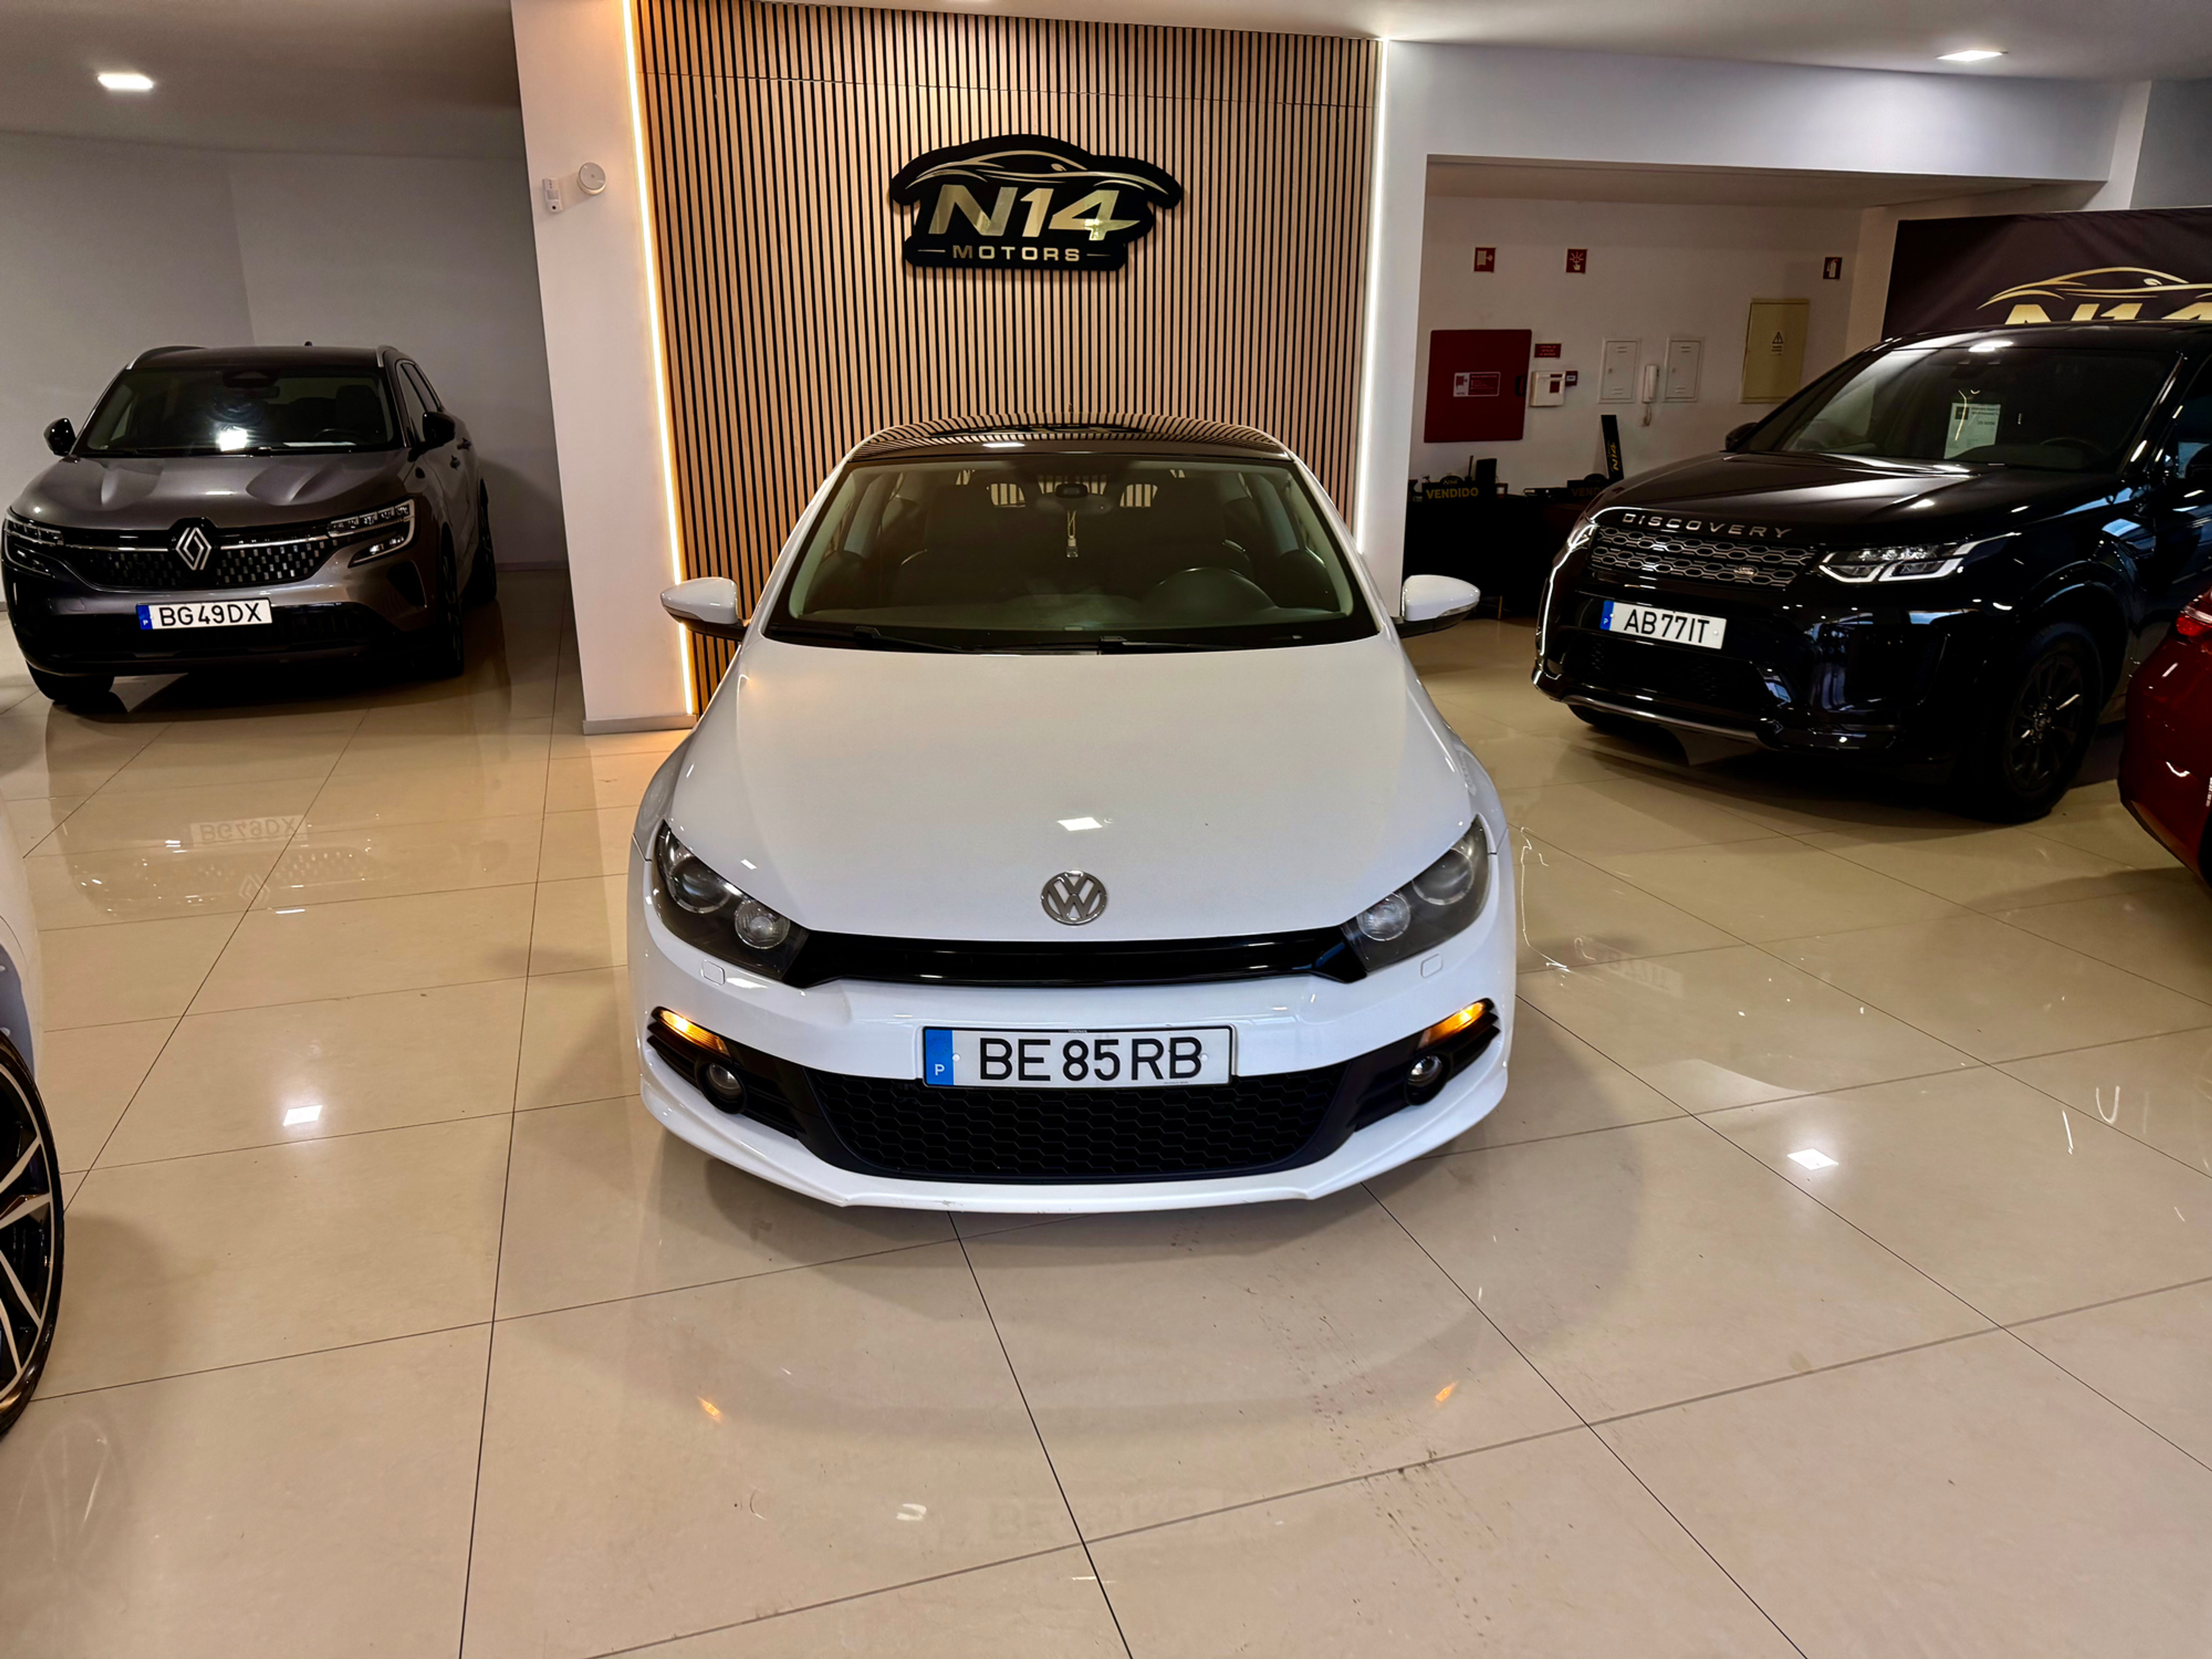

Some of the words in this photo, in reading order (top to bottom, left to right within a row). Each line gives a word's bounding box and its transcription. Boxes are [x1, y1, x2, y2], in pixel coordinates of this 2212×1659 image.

[928, 184, 1140, 241] N14
[952, 245, 1080, 261] MOTORS
[1426, 487, 1479, 499] VENDIDO
[1622, 513, 1793, 538] DISCOVERY
[159, 603, 262, 627] BG49DX
[1624, 609, 1710, 643] AB77IT
[934, 1064, 945, 1075] P
